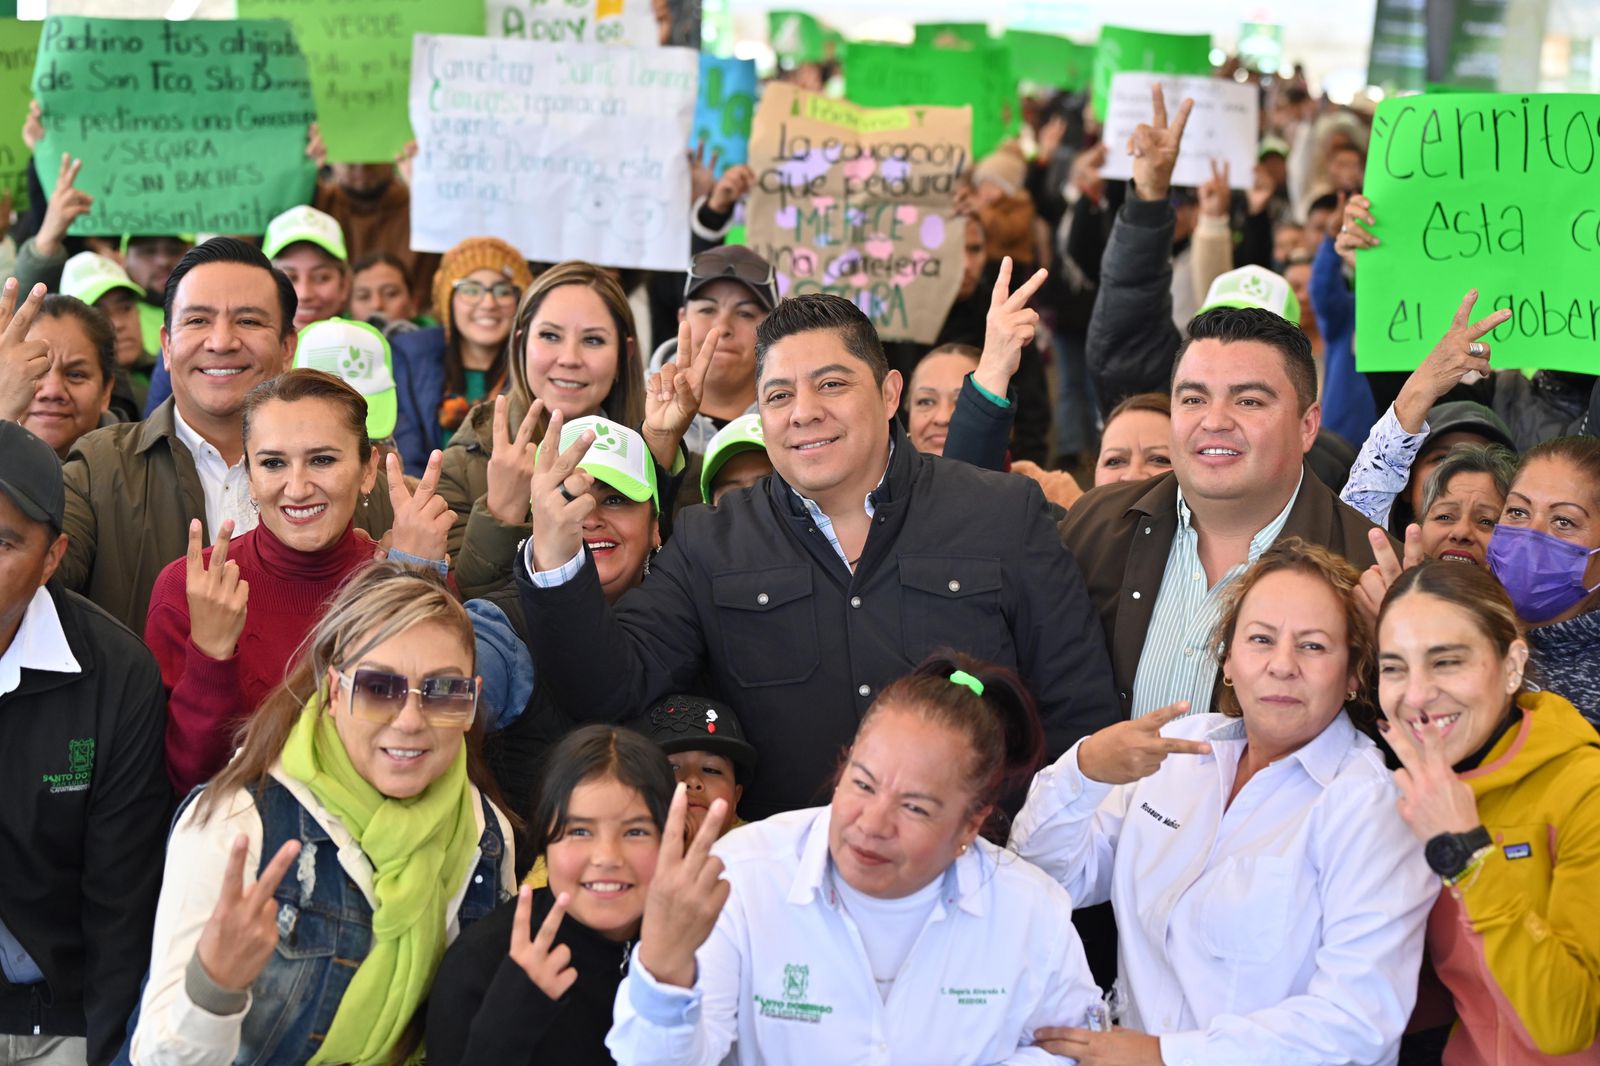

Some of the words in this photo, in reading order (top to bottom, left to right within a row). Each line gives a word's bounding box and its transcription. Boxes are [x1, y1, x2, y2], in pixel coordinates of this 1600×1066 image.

[44, 17, 145, 54] Padrino
[159, 20, 210, 58] tus
[38, 59, 75, 93] de
[85, 60, 141, 93] San
[80, 105, 184, 142] pedimos
[191, 113, 233, 133] una
[119, 138, 219, 169] SEGURA
[122, 172, 165, 197] SIN
[173, 162, 266, 194] BACHES
[758, 167, 828, 216] que
[1422, 201, 1526, 261] esta
[43, 774, 73, 782] SANTO
